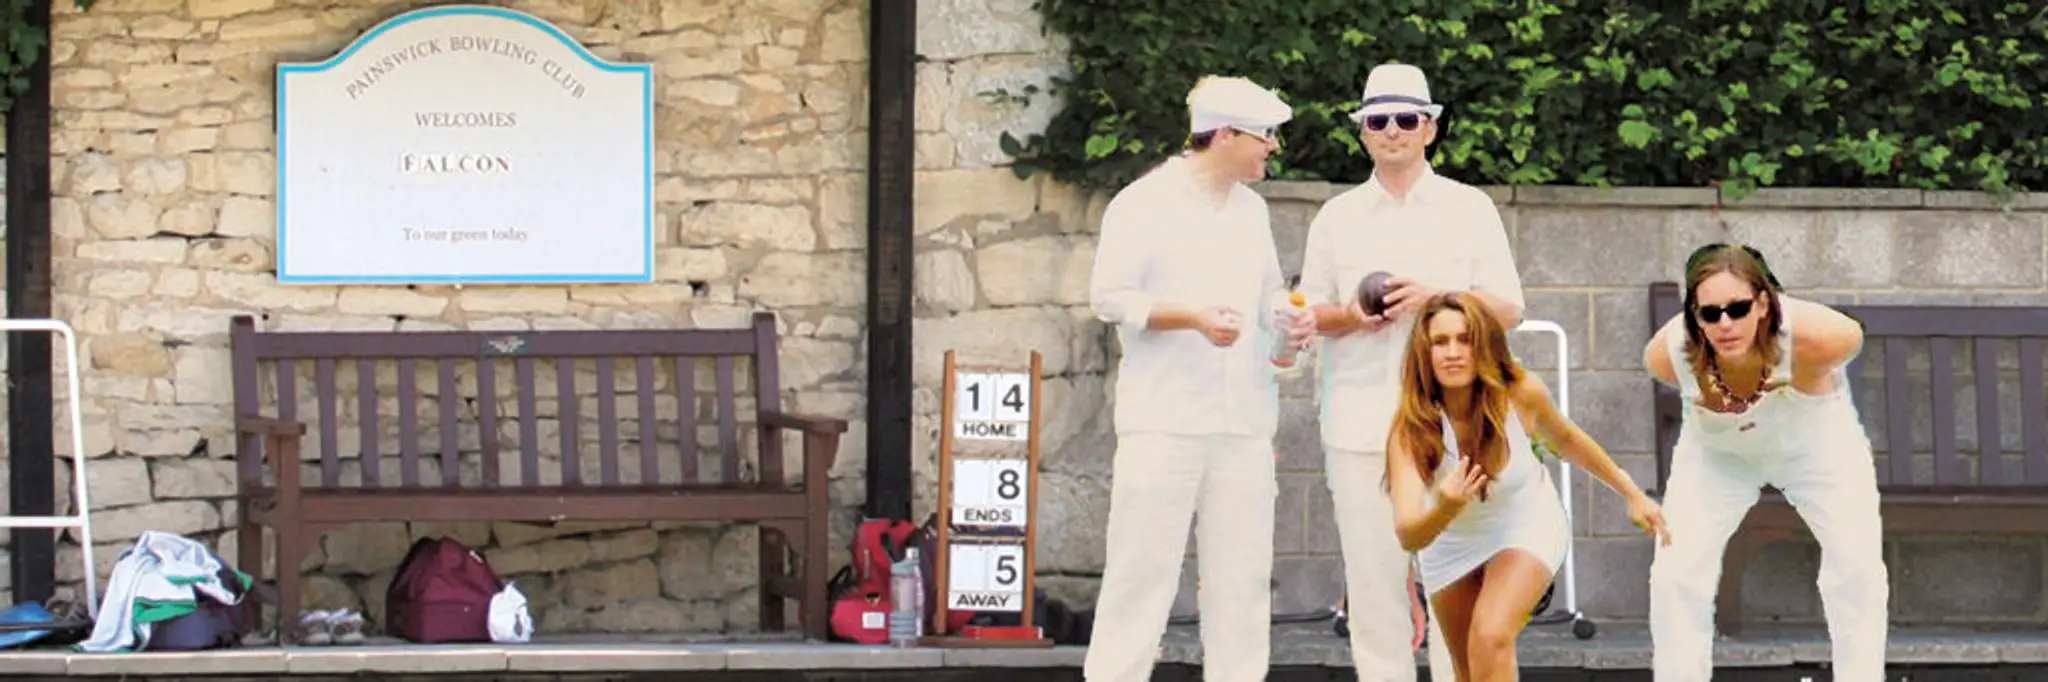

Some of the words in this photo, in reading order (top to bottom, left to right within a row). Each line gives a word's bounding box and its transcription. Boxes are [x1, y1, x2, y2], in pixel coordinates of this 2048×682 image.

[345, 39, 442, 100] PAINSWICK
[450, 36, 537, 66] BOWLING
[542, 60, 586, 99] CLUB
[415, 112, 516, 127] WELCOMES
[404, 154, 510, 172] FALCON
[404, 227, 421, 241] To
[424, 230, 447, 241] our
[450, 229, 488, 243] green
[491, 227, 529, 243] today
[962, 423, 1017, 437] HOME
[997, 469, 1020, 500] 8
[963, 508, 1012, 522] ENDS
[995, 556, 1017, 585] 5
[956, 594, 1010, 607] AWAY
